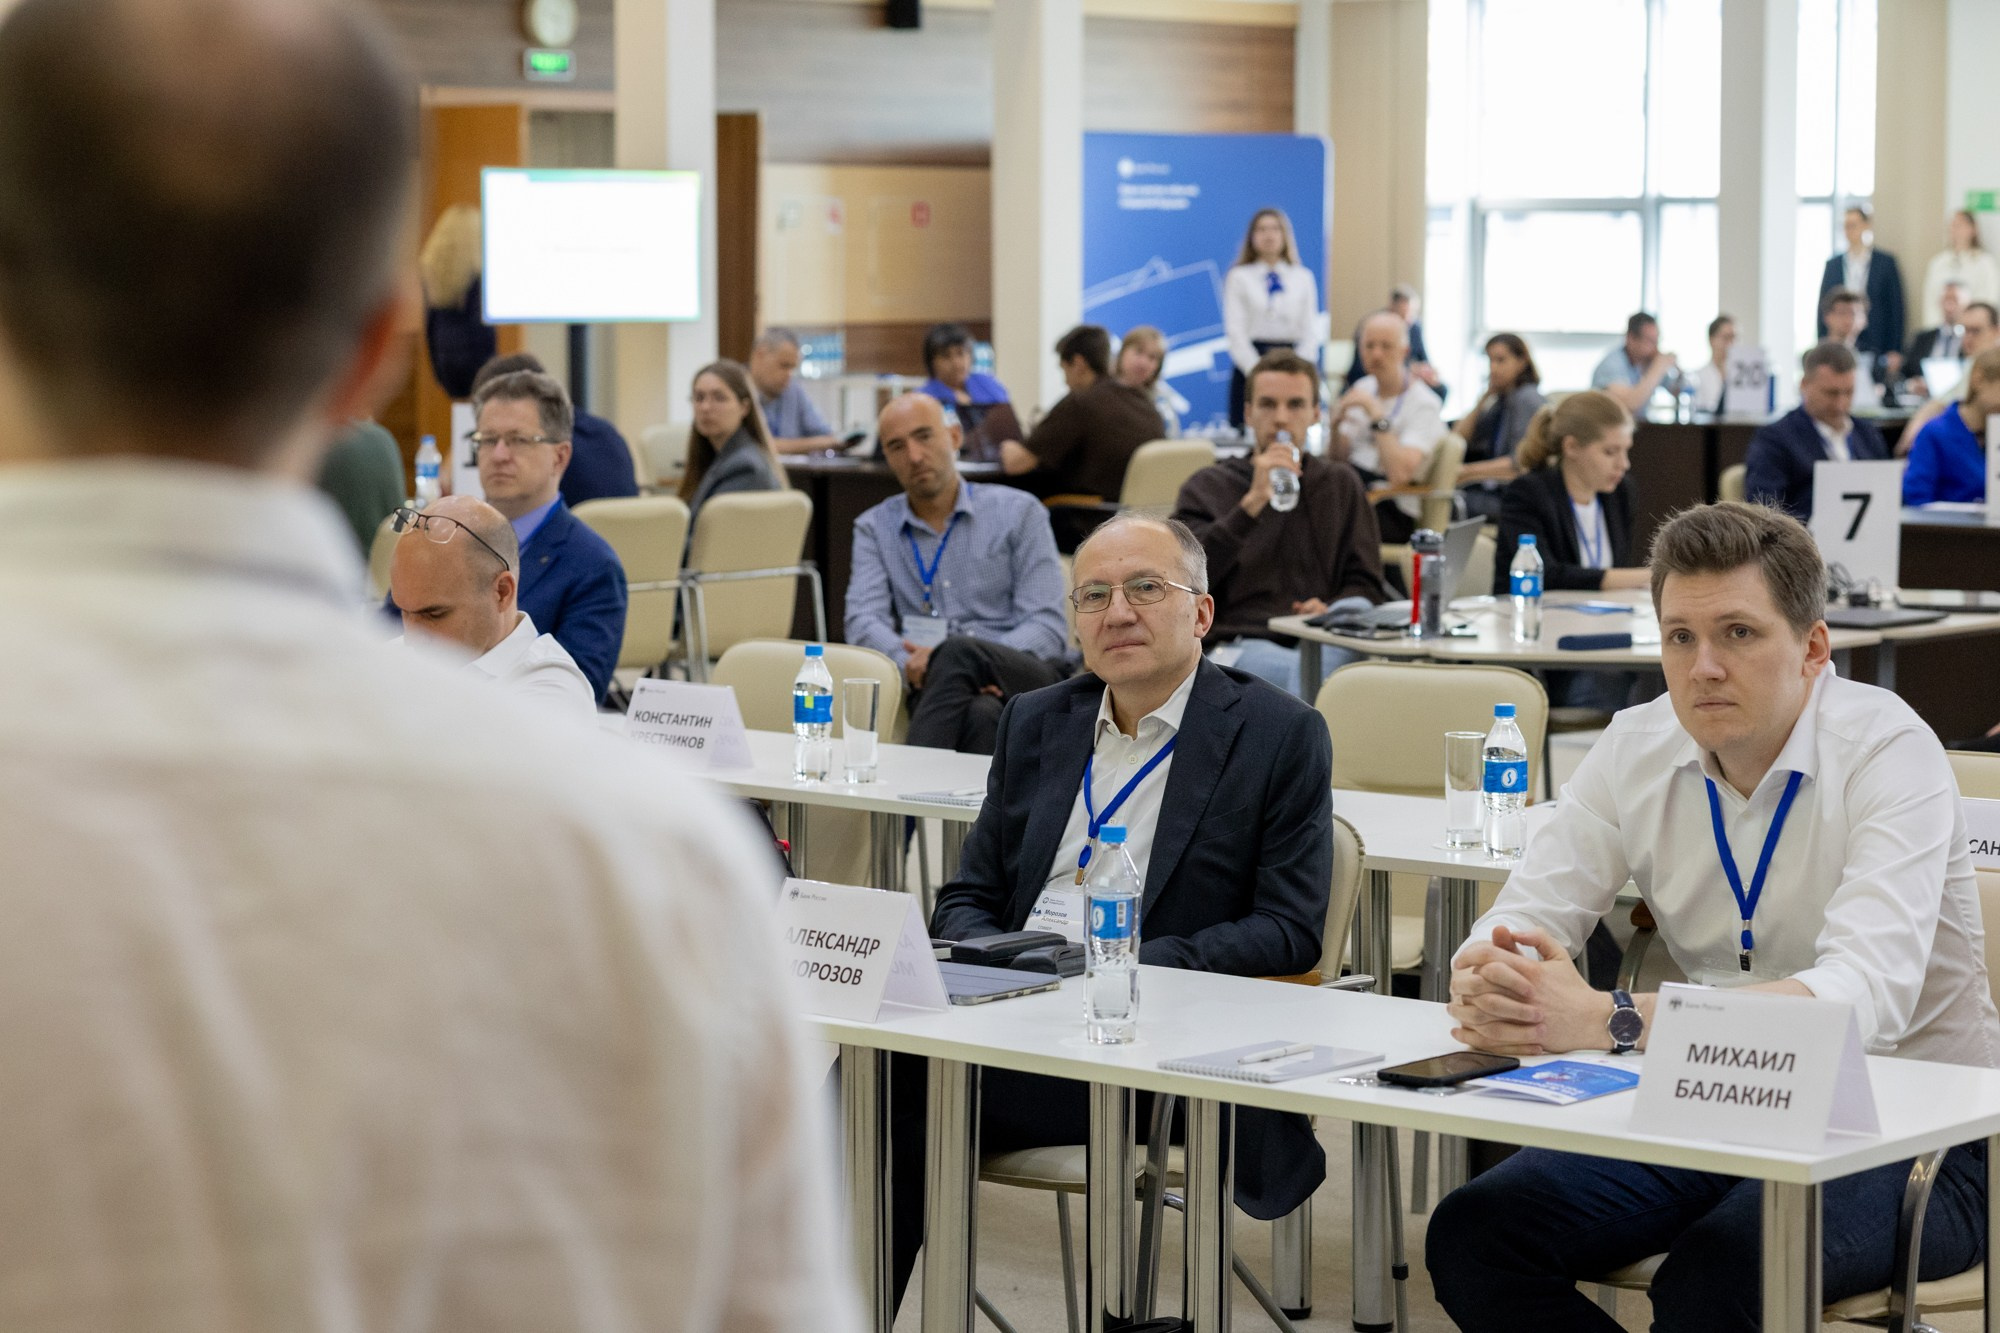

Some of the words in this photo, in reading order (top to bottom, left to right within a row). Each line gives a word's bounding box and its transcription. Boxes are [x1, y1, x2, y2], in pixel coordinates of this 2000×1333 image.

[1841, 492, 1873, 542] 7
[633, 710, 713, 729] КОНСТАНТИН
[1686, 1043, 1796, 1073] МИХАИЛ
[1674, 1079, 1792, 1110] БАЛАКИН
